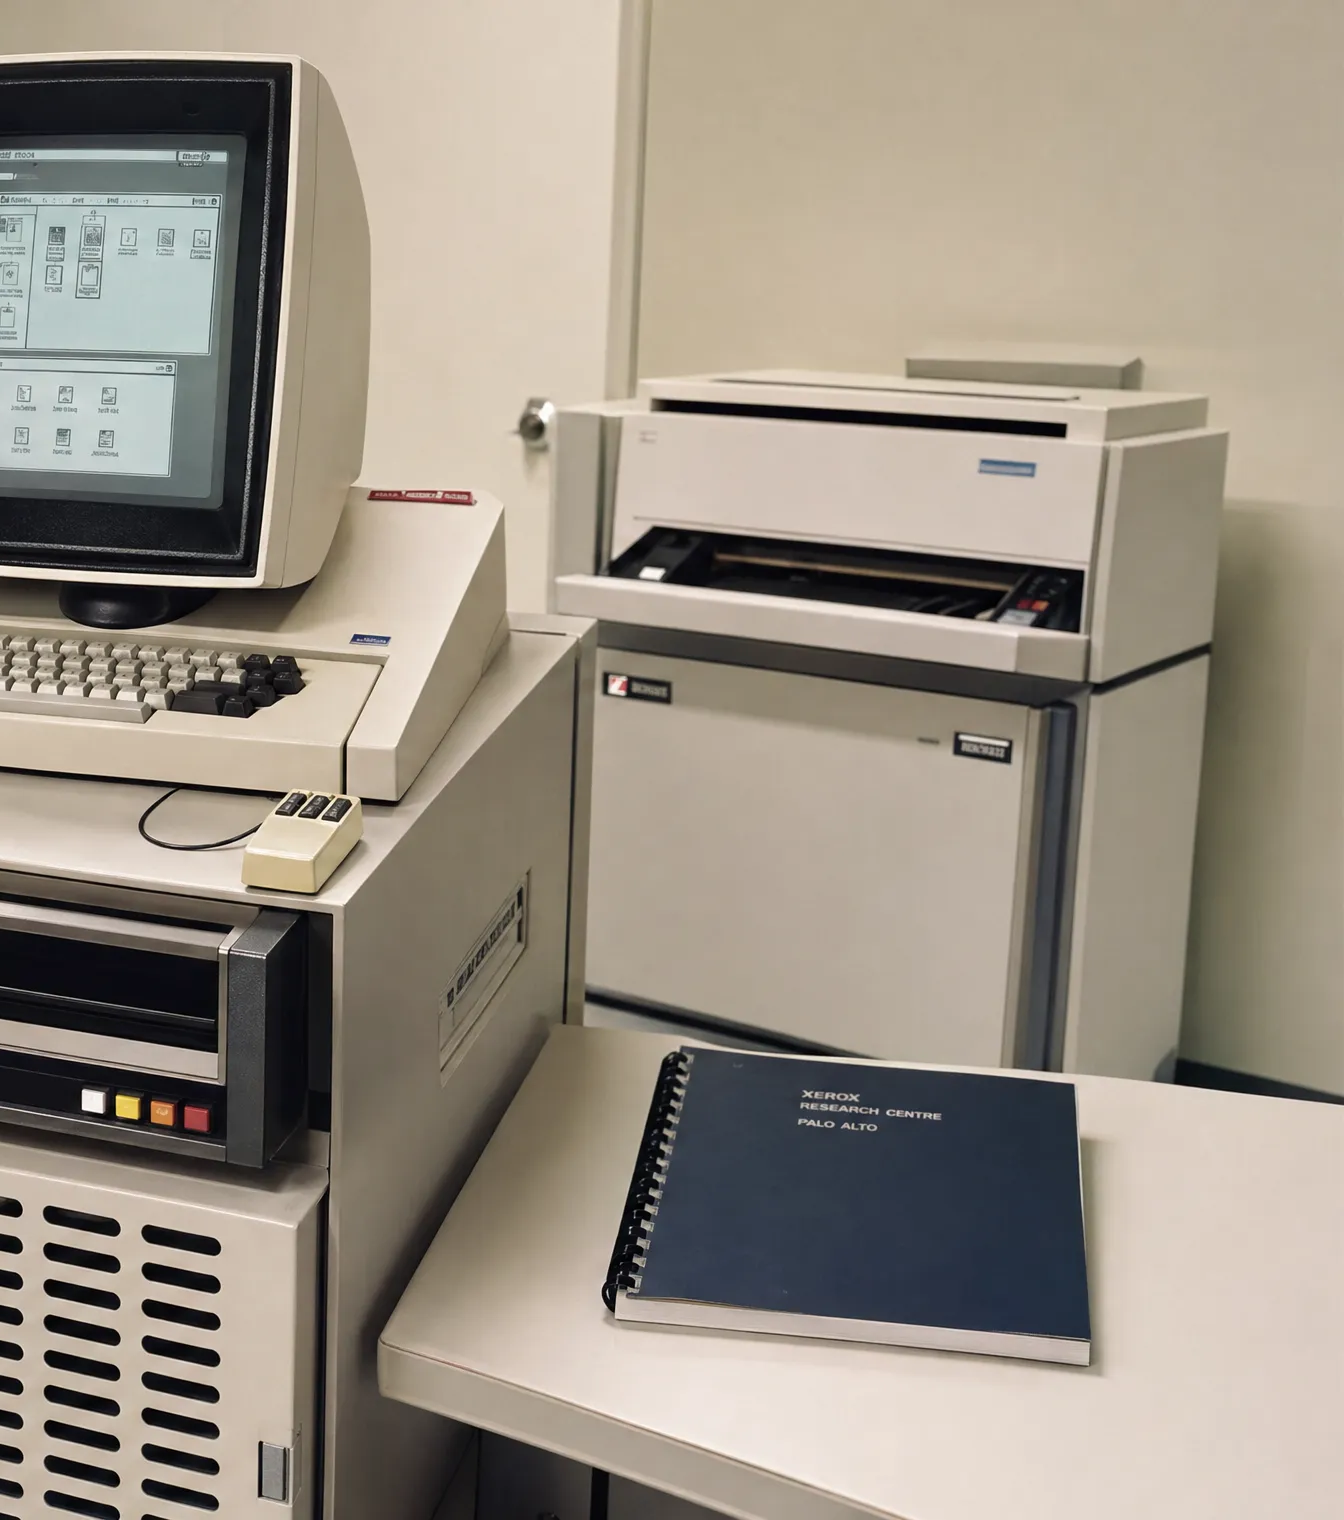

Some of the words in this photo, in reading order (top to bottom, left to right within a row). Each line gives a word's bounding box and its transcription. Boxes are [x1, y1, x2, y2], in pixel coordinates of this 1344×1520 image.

[802, 1089, 861, 1102] XEROX
[800, 1102, 879, 1116] RESEARCH
[886, 1108, 943, 1121] CENTRE
[797, 1118, 835, 1129] PALO
[840, 1122, 878, 1132] ALTO
